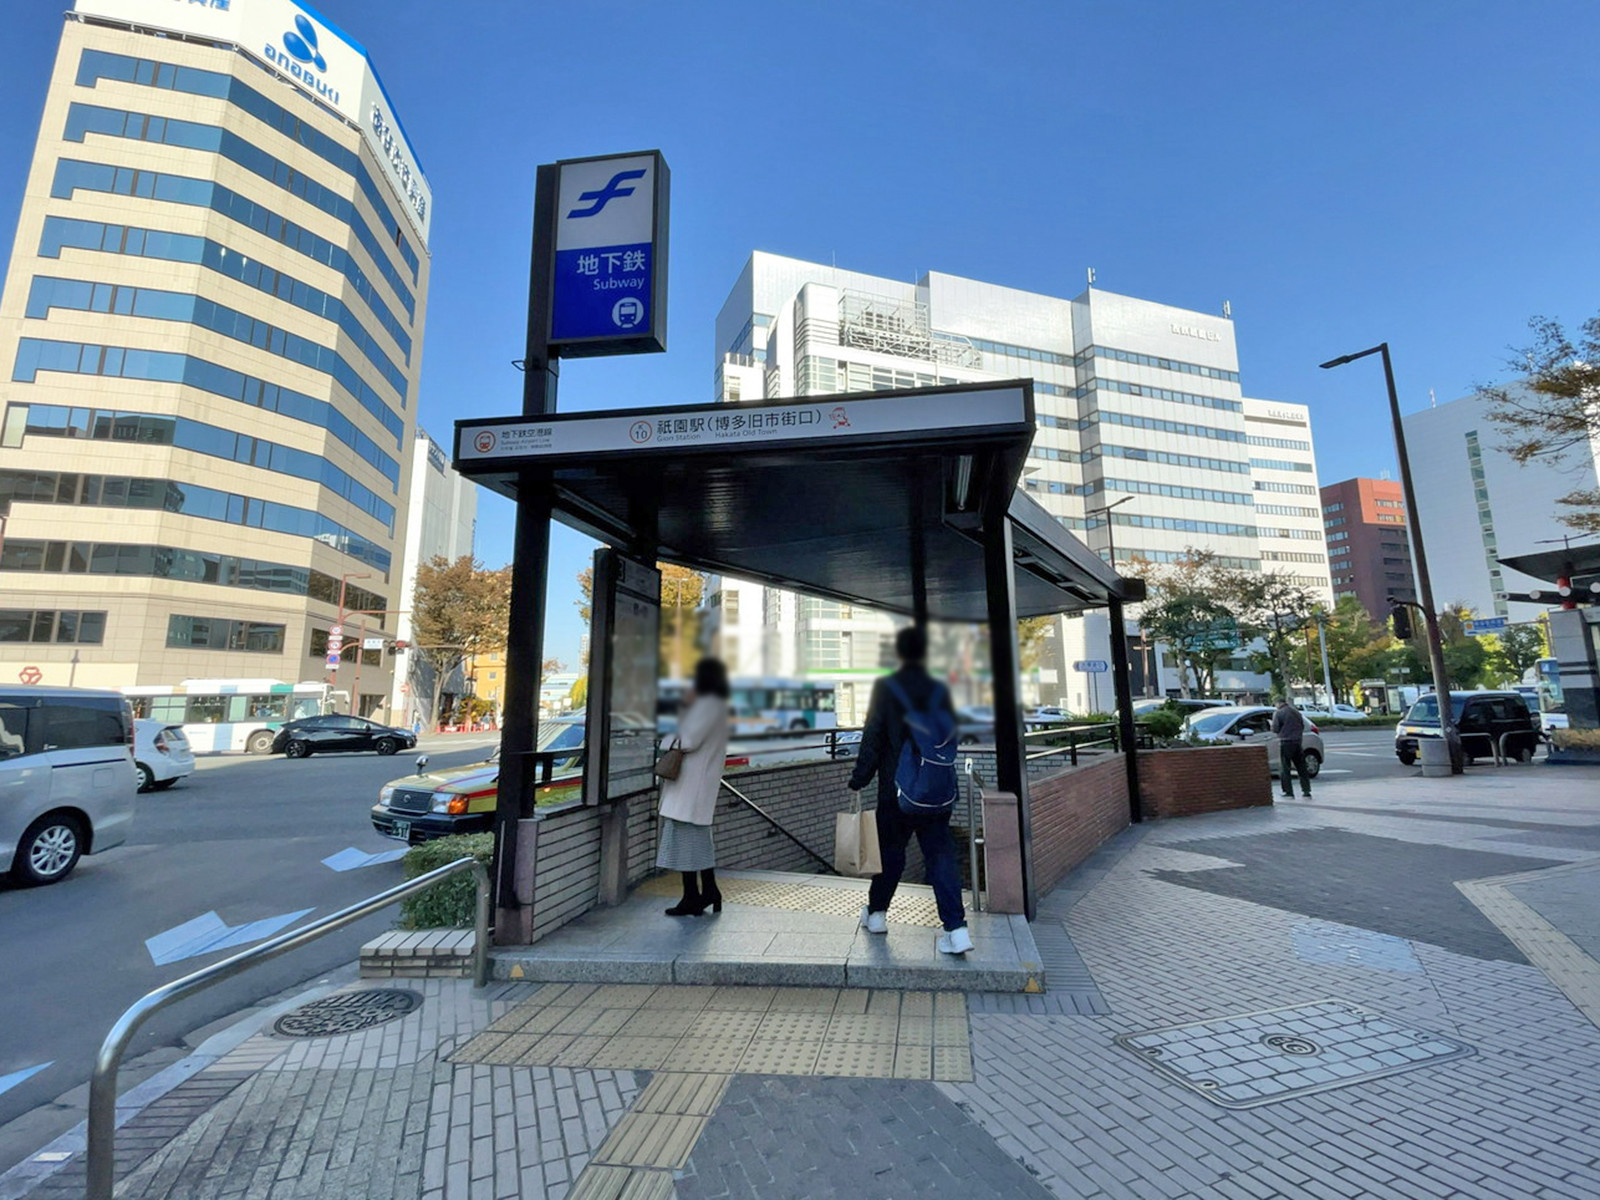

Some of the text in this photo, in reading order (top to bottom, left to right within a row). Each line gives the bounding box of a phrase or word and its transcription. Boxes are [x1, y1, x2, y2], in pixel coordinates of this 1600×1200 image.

[576, 250, 645, 275] 地下鉄
[593, 277, 645, 291] Subway
[501, 428, 553, 439] 地下鉄空港線
[635, 431, 648, 439] 10
[675, 433, 701, 441] Station
[715, 428, 778, 438] Hakata Old Town
